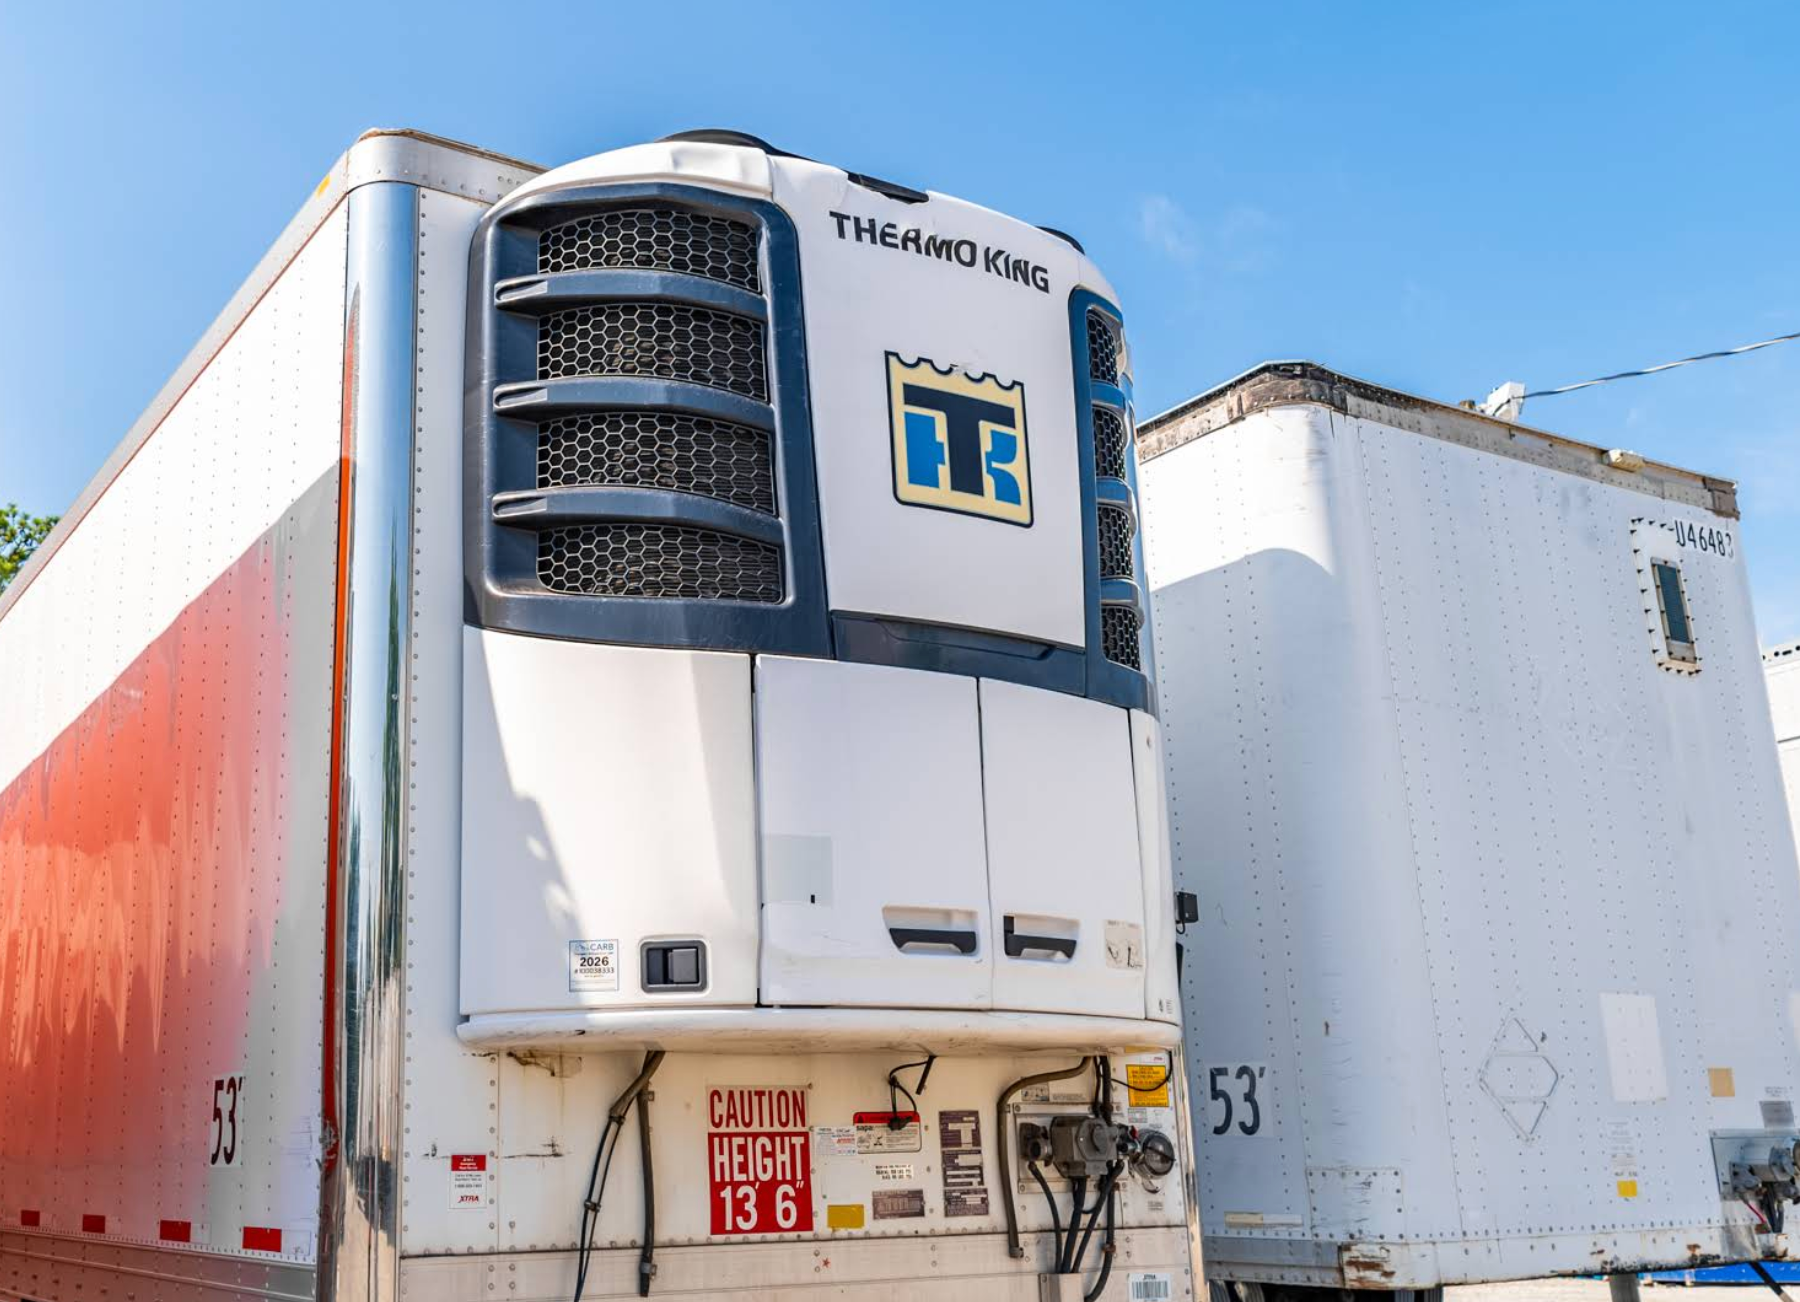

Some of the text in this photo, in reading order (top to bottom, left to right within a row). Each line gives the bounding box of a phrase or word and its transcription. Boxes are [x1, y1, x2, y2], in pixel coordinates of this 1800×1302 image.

[829, 210, 1050, 294] THERMO KING
[580, 956, 609, 967] 2026
[589, 943, 614, 951] CARB
[210, 1076, 244, 1166] 53'
[709, 1089, 807, 1129] CAUTION
[1209, 1064, 1266, 1136] 53'
[713, 1135, 805, 1182] HEIGHT
[719, 1180, 805, 1231] 13' 6"
